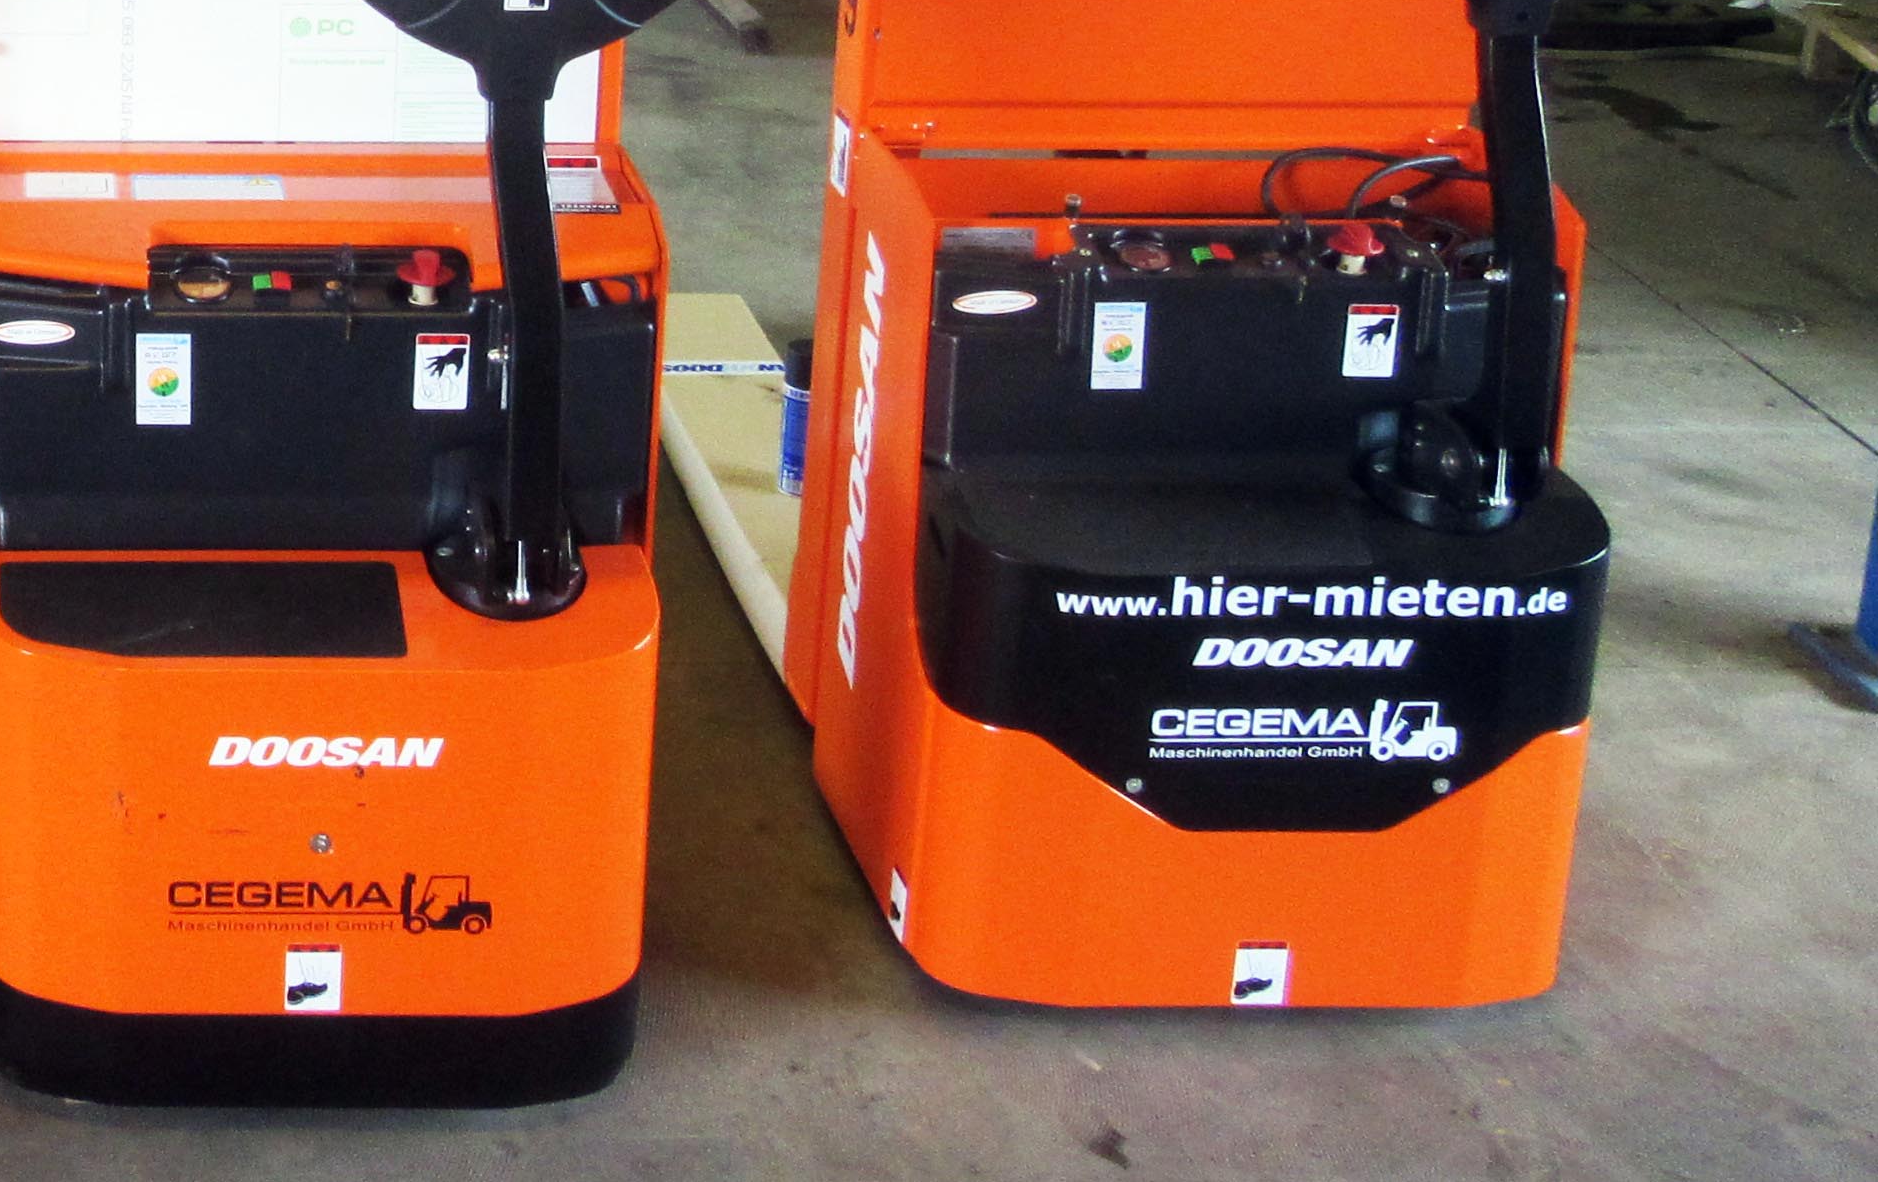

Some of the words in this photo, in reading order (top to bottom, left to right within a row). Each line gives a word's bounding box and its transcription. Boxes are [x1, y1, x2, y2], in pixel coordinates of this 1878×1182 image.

[663, 363, 724, 373] DOOS
[837, 230, 886, 690] DOOSAN
[1055, 575, 1568, 617] www.hier-mieten.de
[1192, 637, 1414, 668] DOOSAN
[1150, 707, 1365, 737] CEGEMA
[207, 735, 445, 768] DOOSAN
[1148, 745, 1303, 760] Maschinenhandel
[1306, 745, 1363, 760] GmbH
[168, 881, 394, 909] CEGEMA
[167, 919, 330, 933] Maschinenhandel
[335, 920, 394, 932] GmbH
